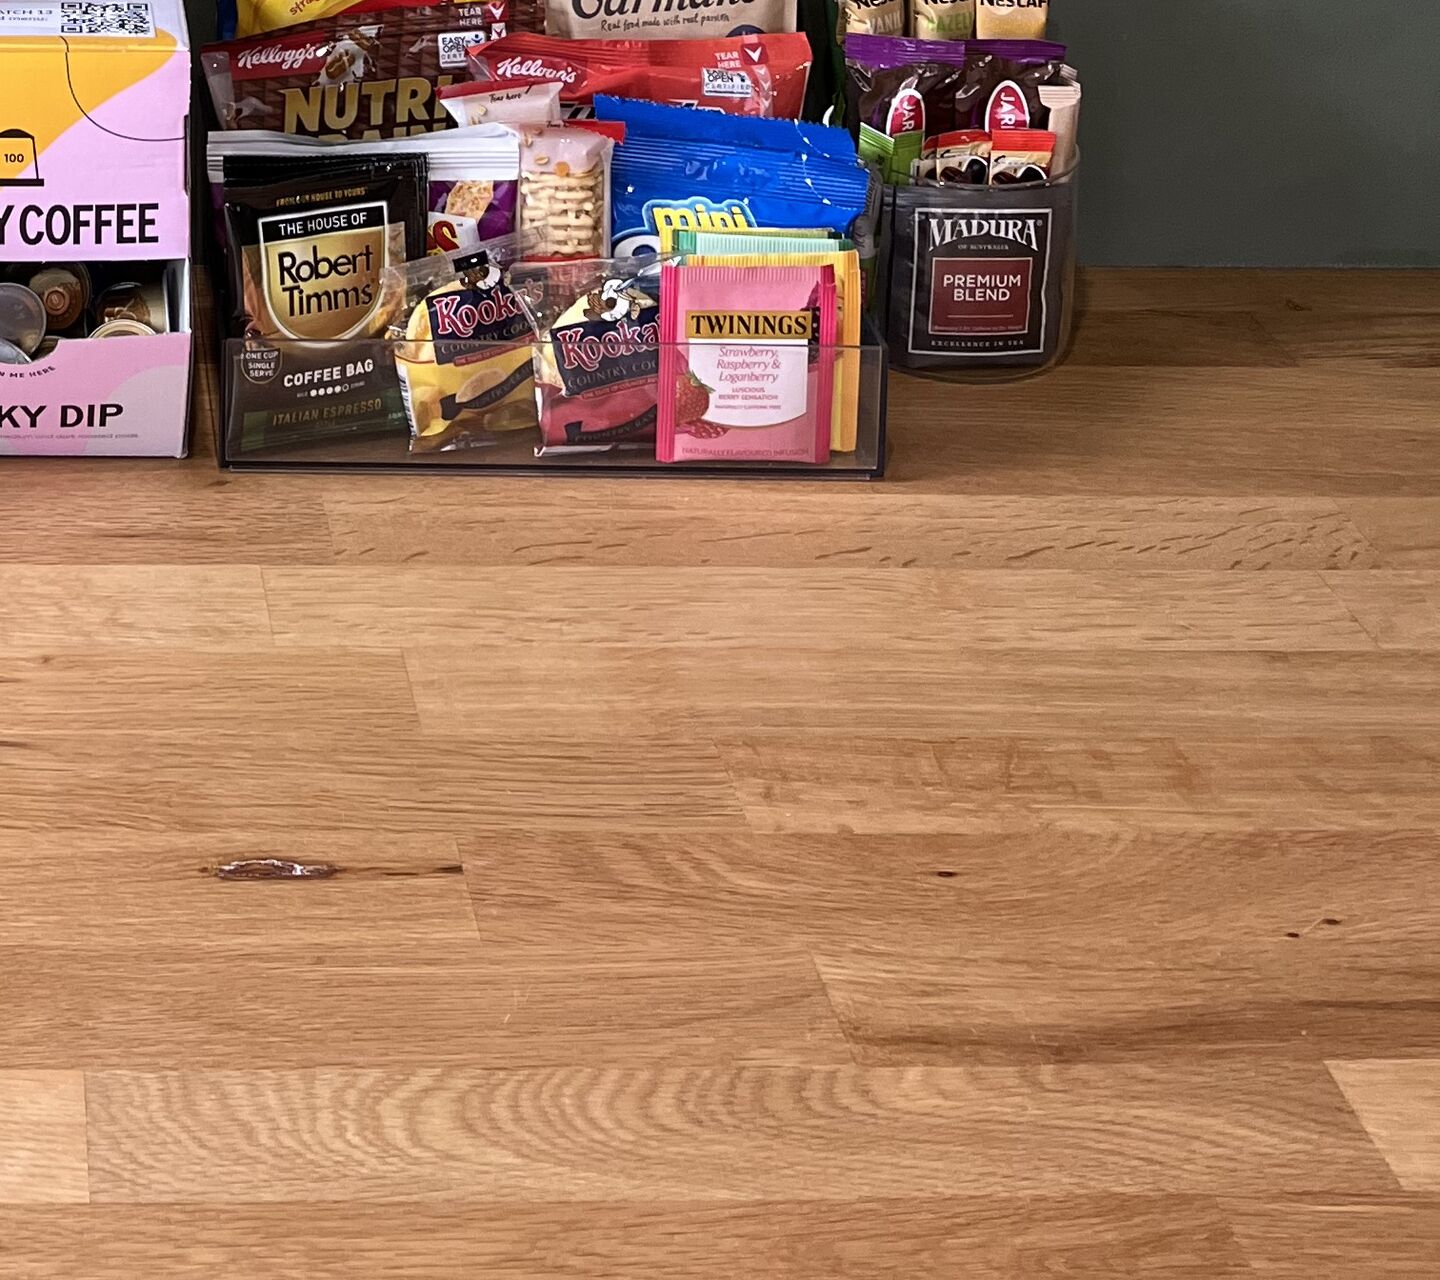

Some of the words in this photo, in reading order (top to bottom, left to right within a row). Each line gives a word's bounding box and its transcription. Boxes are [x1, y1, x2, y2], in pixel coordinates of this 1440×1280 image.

[458, 7, 482, 17] TEAR
[459, 18, 484, 26] HERE
[600, 20, 621, 32] Real
[623, 18, 640, 31] food
[642, 17, 661, 27] made
[663, 14, 680, 26] with
[682, 13, 699, 24] real
[441, 36, 466, 45] EASY
[237, 42, 317, 69] Kellogg's
[714, 51, 740, 60] TEAR
[717, 59, 742, 68] HERE
[707, 72, 734, 82] OPEN
[4, 153, 25, 163] 100
[279, 221, 304, 236] THE
[307, 214, 348, 232] HOUSE
[351, 212, 368, 225] OF
[652, 204, 749, 231] mini
[19, 203, 159, 246] COFFEE
[928, 218, 1039, 251] MADURA
[278, 245, 373, 285] Robert
[943, 274, 1022, 288] PREMIUM
[282, 284, 373, 317] Timms
[953, 289, 1011, 302] BLEND
[691, 314, 808, 335] TWININGS
[245, 352, 262, 360] ONE
[263, 351, 279, 359] CUP
[718, 345, 779, 358] Strawberry,
[247, 362, 276, 370] SINGLE
[716, 358, 770, 371] Raspberry
[771, 359, 782, 370] &
[29, 366, 56, 378] HERE
[249, 370, 274, 378] SERVE
[283, 366, 342, 388] COFFEE
[345, 359, 374, 378] BAG
[718, 371, 779, 384] Loganberry
[60, 403, 124, 428] DIP
[272, 408, 320, 426] ITALIAN
[323, 398, 383, 418] ESPRESSO
